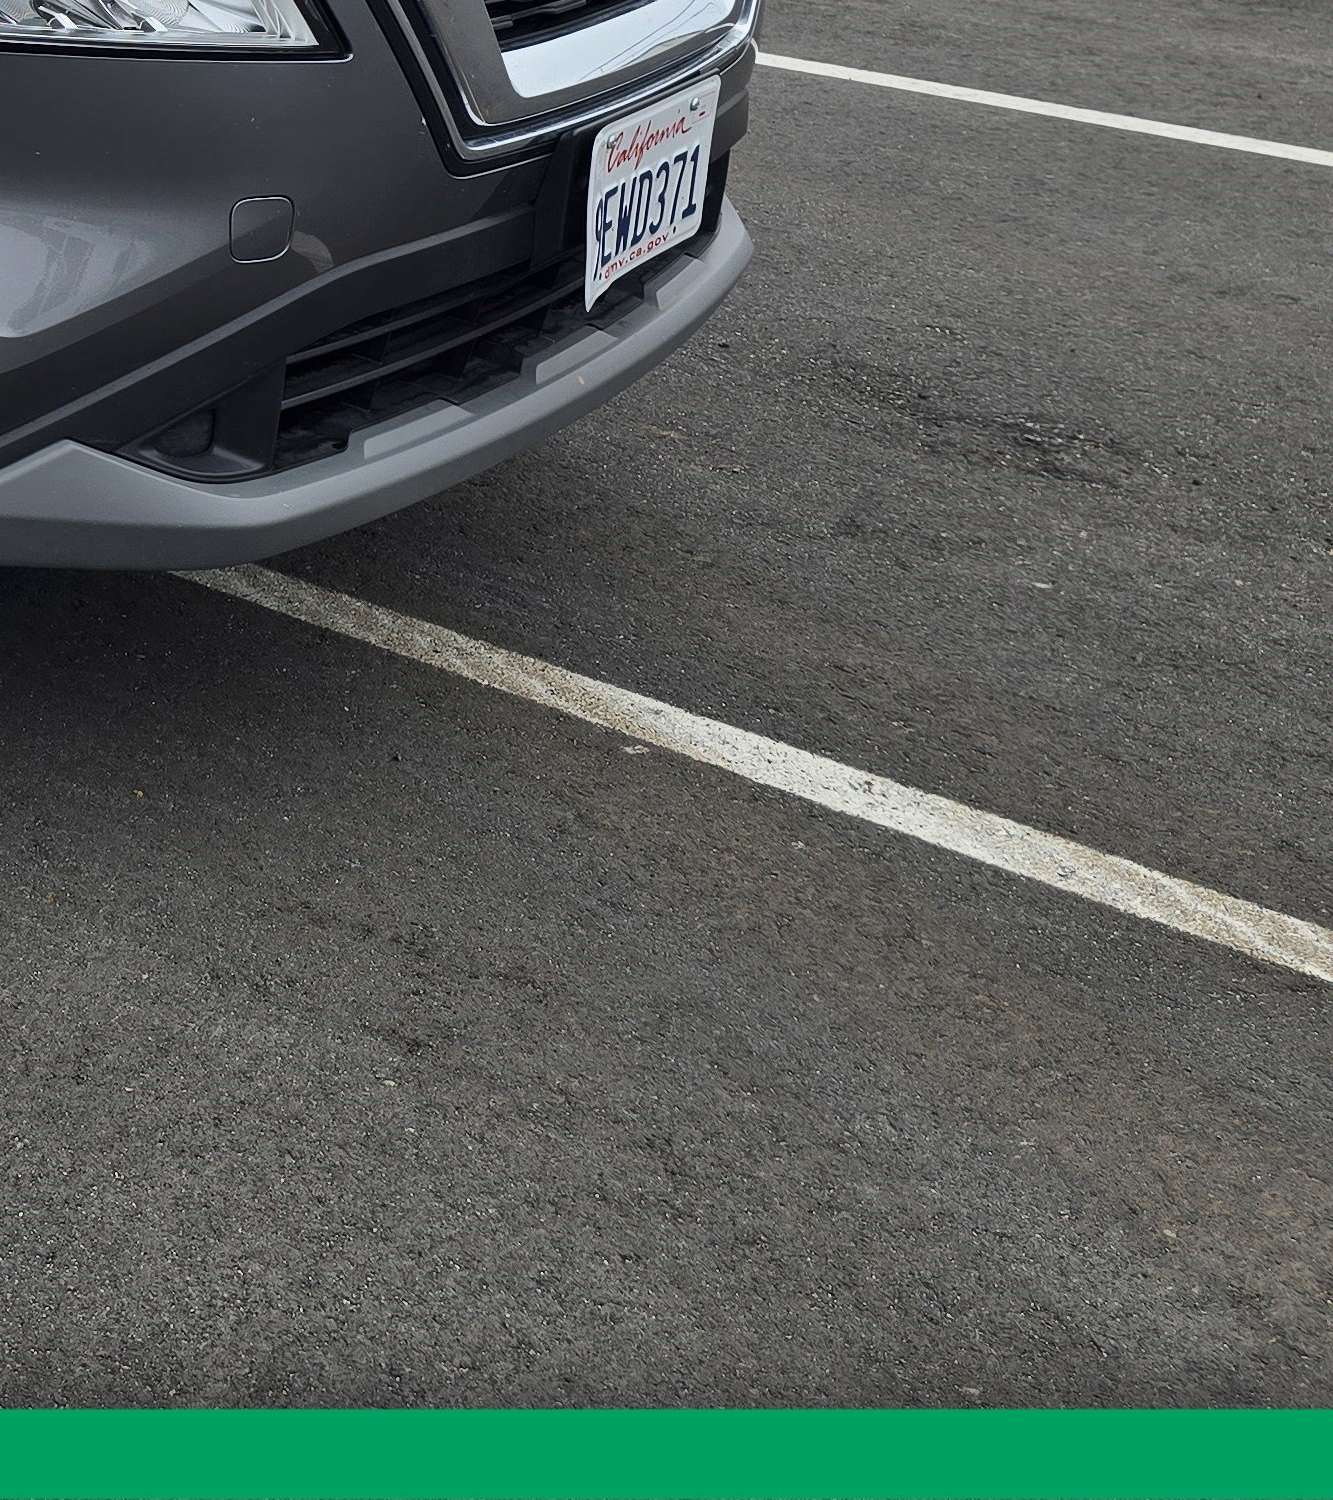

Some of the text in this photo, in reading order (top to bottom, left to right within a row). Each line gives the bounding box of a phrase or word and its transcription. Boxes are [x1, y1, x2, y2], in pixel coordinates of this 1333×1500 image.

[606, 108, 693, 173] California
[593, 144, 701, 282] 9EWD371
[603, 231, 670, 280] dmv.ca.gov
